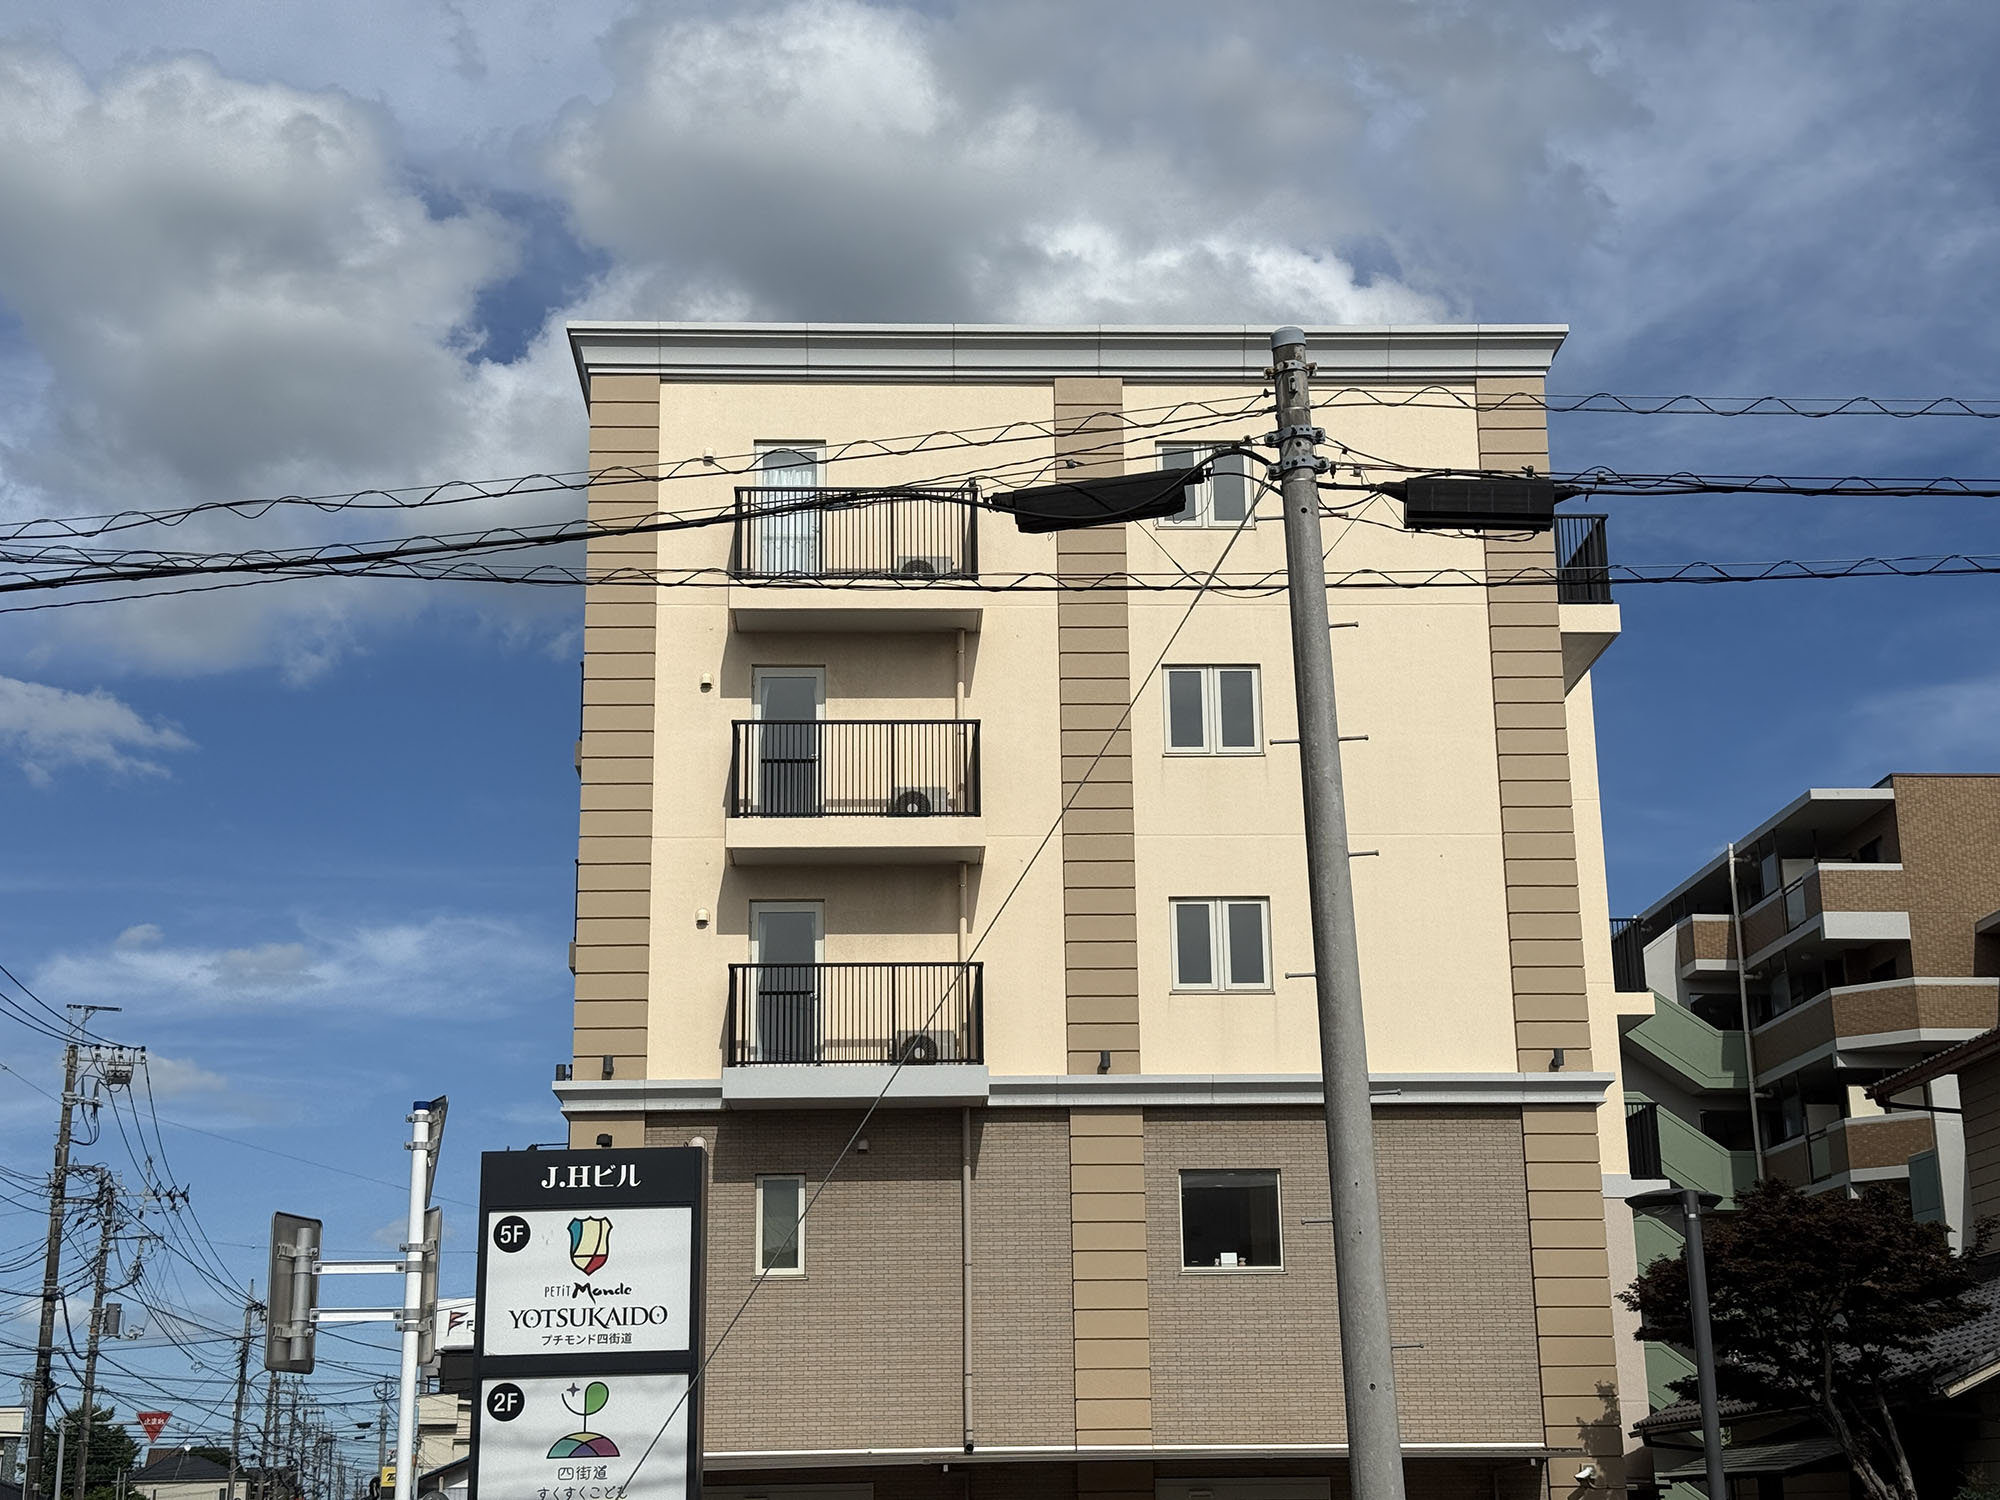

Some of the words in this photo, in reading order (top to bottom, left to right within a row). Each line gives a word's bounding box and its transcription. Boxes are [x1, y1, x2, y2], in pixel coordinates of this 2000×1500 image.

[541, 1164, 642, 1189] J.Hビル
[500, 1225, 524, 1244] 5F
[571, 1282, 632, 1305] Monde
[508, 1305, 668, 1330] YOTSUKAIDO
[541, 1332, 633, 1346] プチモンド四街道
[493, 1392, 519, 1412] 2F
[557, 1464, 608, 1481] 四街道
[536, 1485, 628, 1500] すくすくこども
